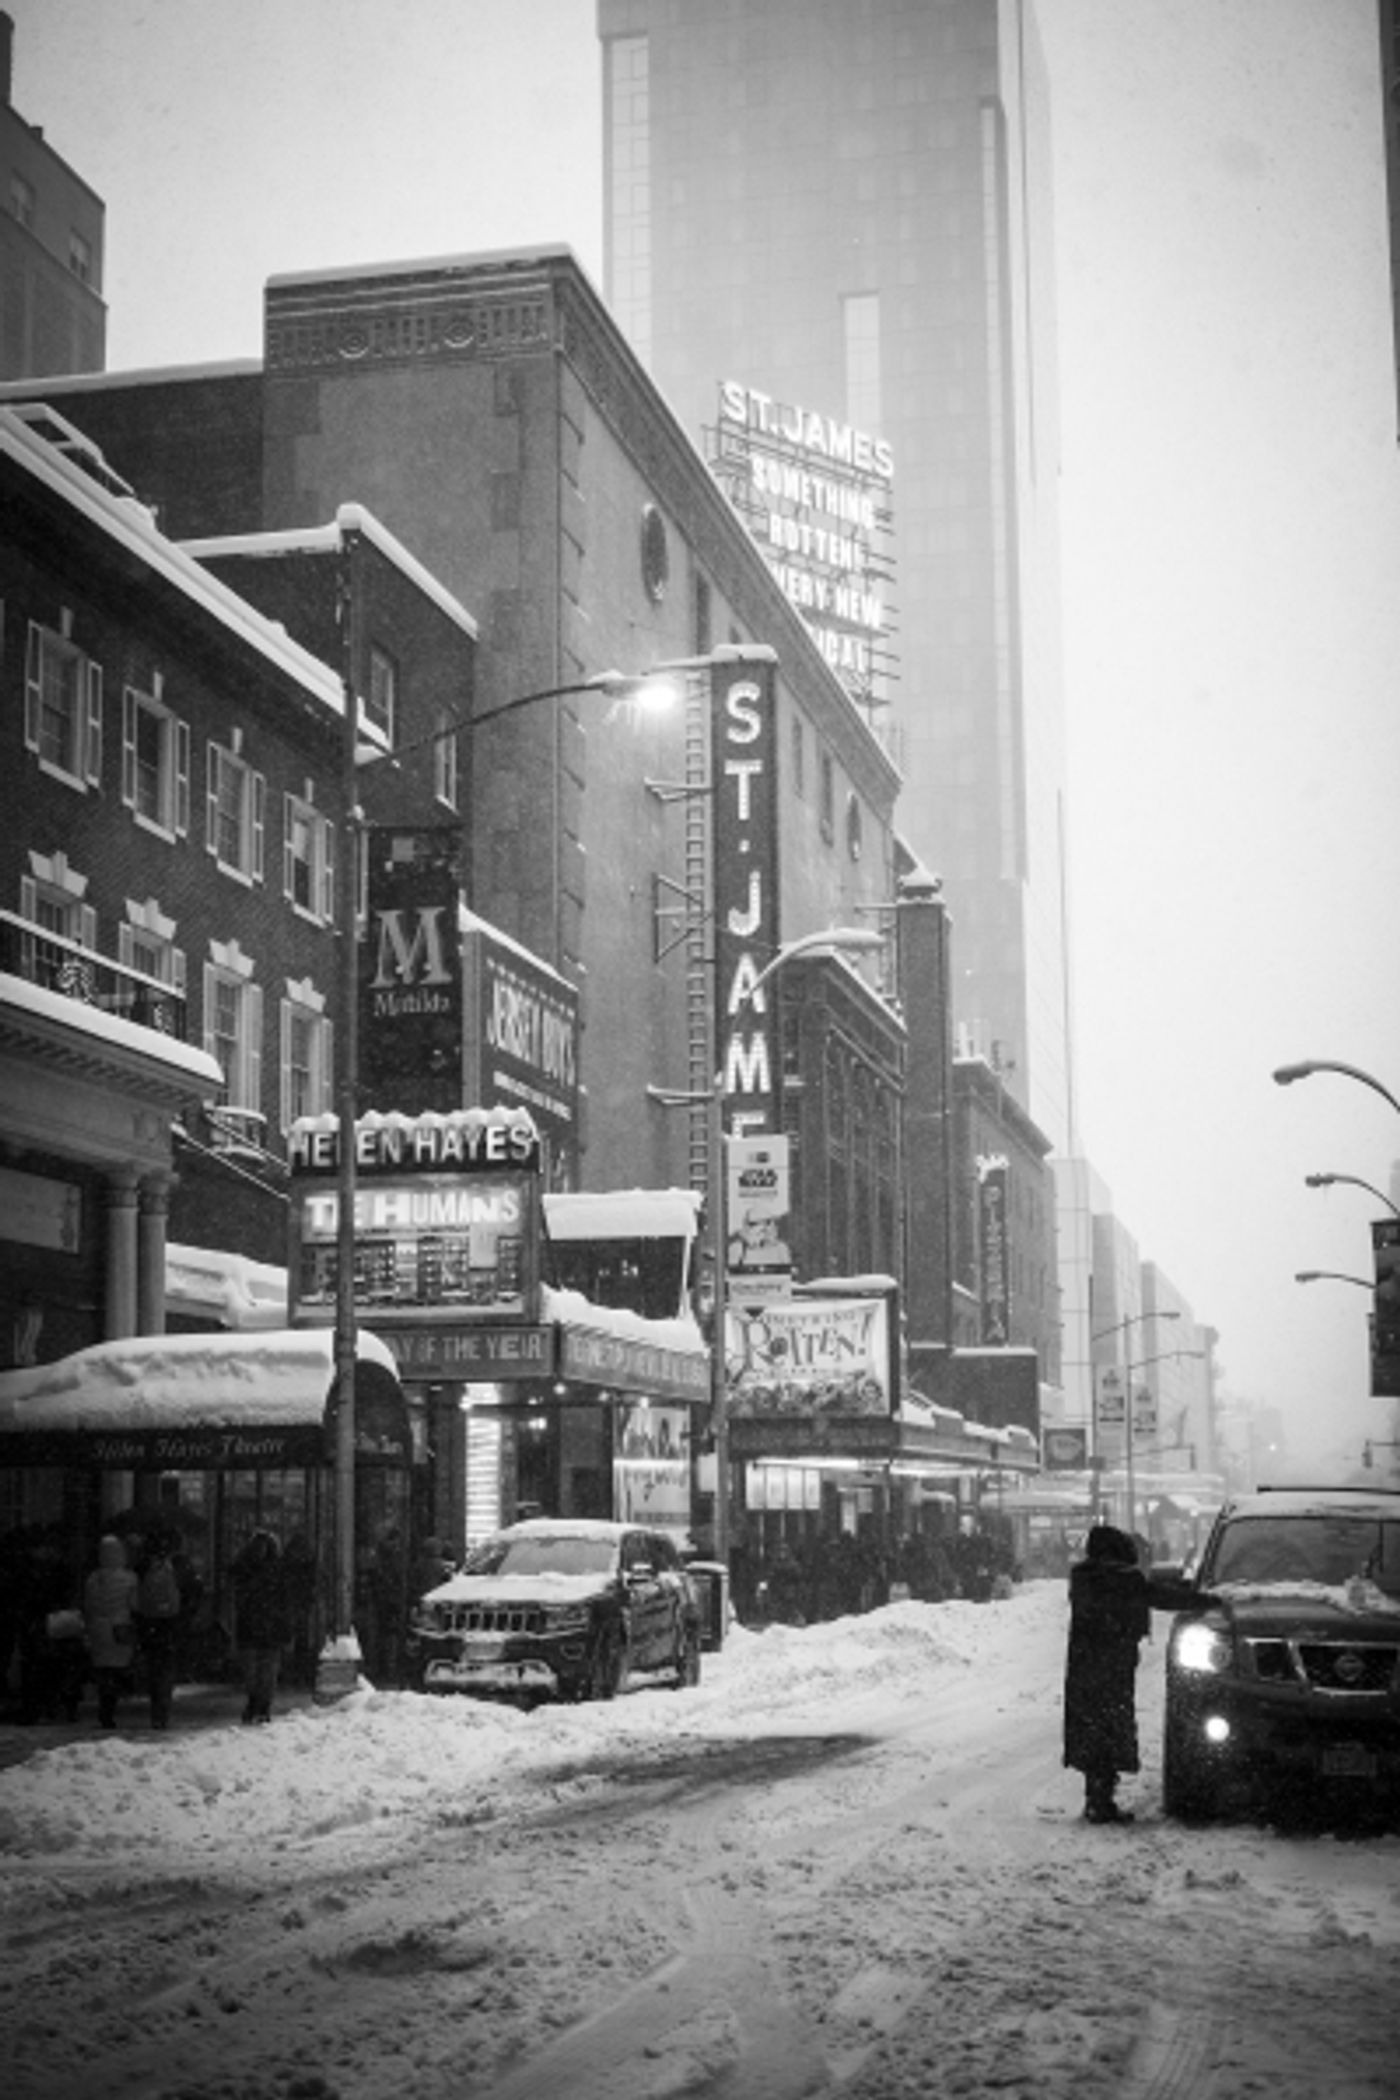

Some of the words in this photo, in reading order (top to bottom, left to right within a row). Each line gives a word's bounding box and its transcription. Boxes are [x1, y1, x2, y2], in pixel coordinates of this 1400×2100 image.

[836, 585, 881, 629] NEW
[415, 1123, 533, 1162] HAYES
[373, 1188, 519, 1226] HUMANS
[441, 1333, 481, 1361] THE
